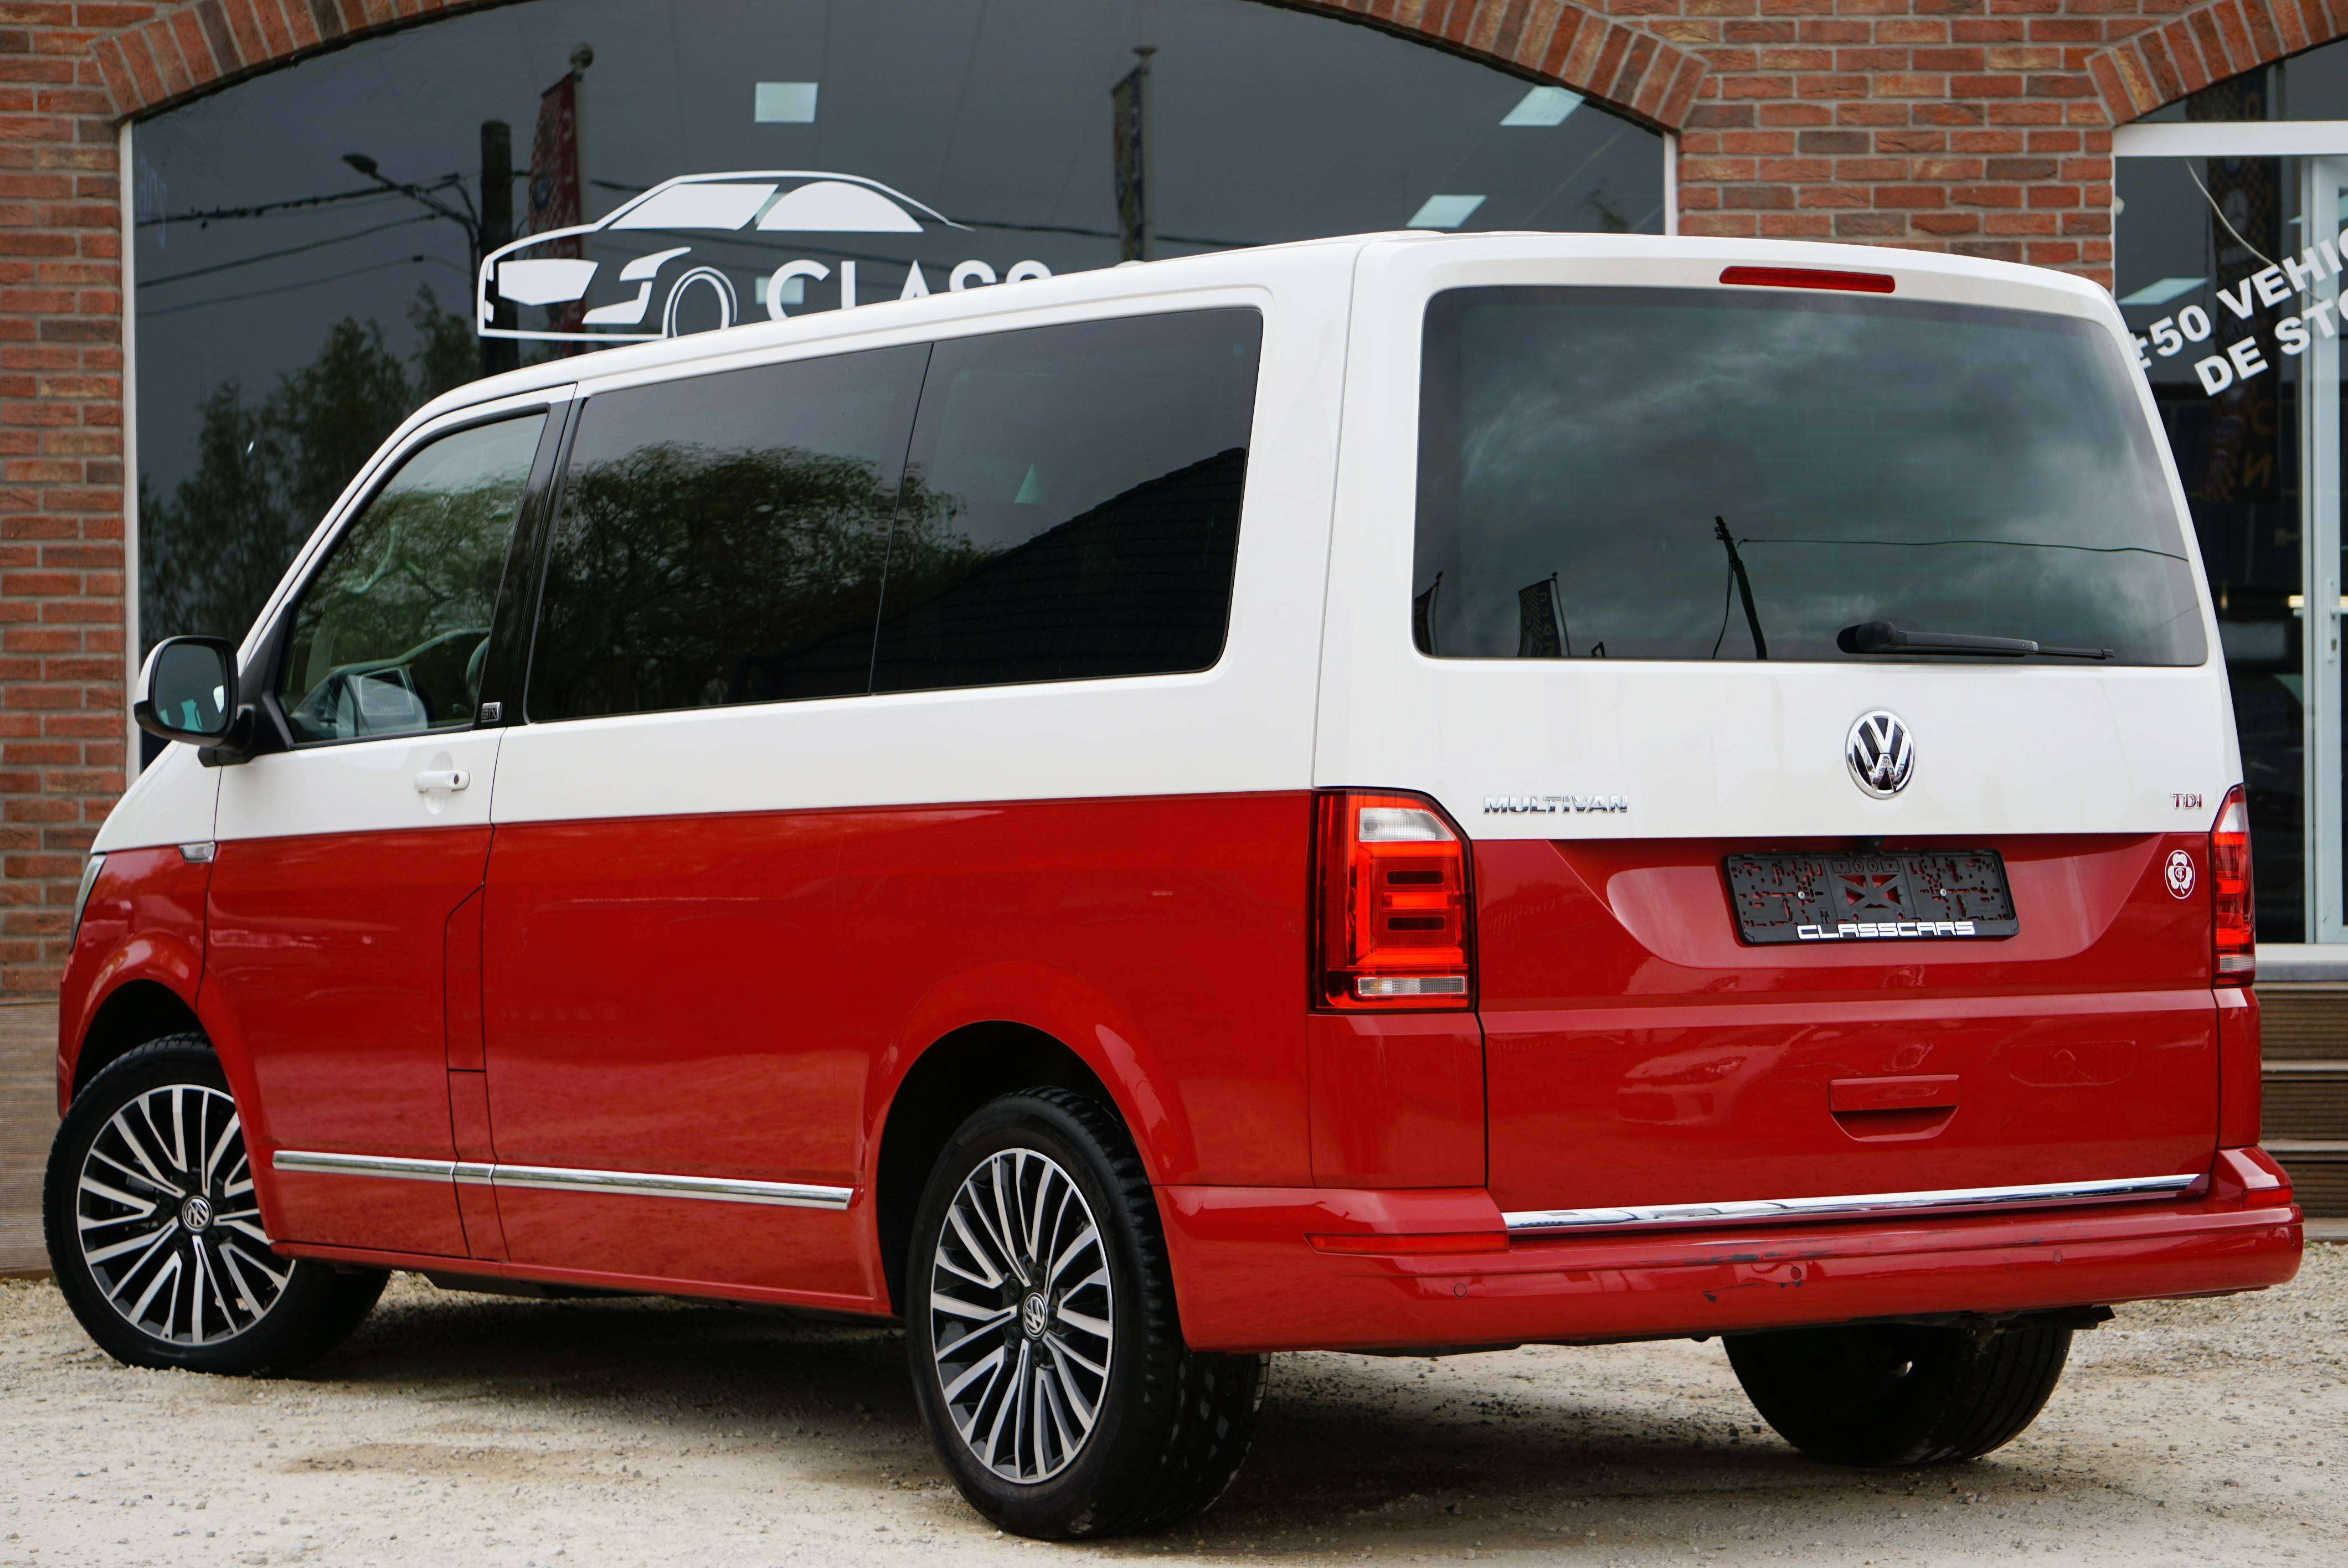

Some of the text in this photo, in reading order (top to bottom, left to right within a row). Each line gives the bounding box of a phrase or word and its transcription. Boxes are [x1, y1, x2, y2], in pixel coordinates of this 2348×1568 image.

[2215, 228, 2348, 320] VEHI
[2194, 288, 2348, 396] DE ST
[1846, 711, 1914, 799] VW
[1484, 795, 1629, 814] MULTIVAN
[2170, 793, 2202, 809] TDI
[1797, 921, 1976, 940] CLASSCARS
